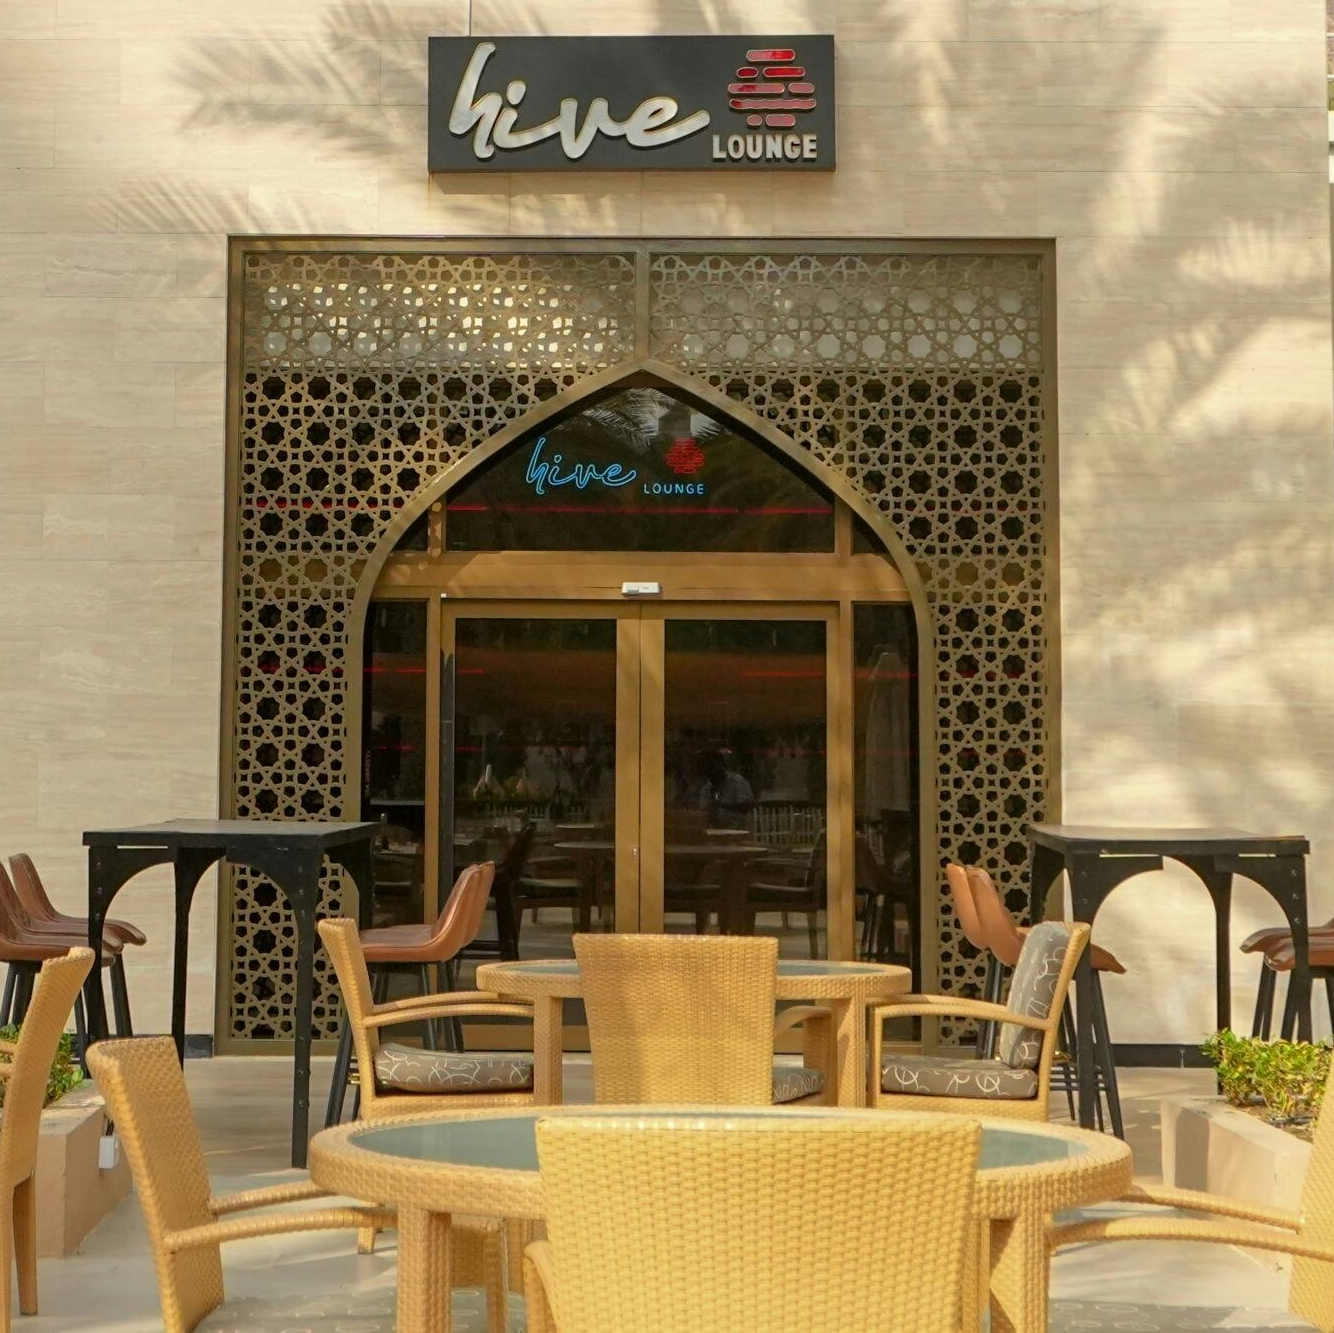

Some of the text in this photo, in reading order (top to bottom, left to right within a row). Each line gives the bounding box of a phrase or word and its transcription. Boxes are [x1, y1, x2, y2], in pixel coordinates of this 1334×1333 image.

[448, 41, 818, 161] hive LOUNGE
[526, 437, 705, 495] hive LOUNGE
